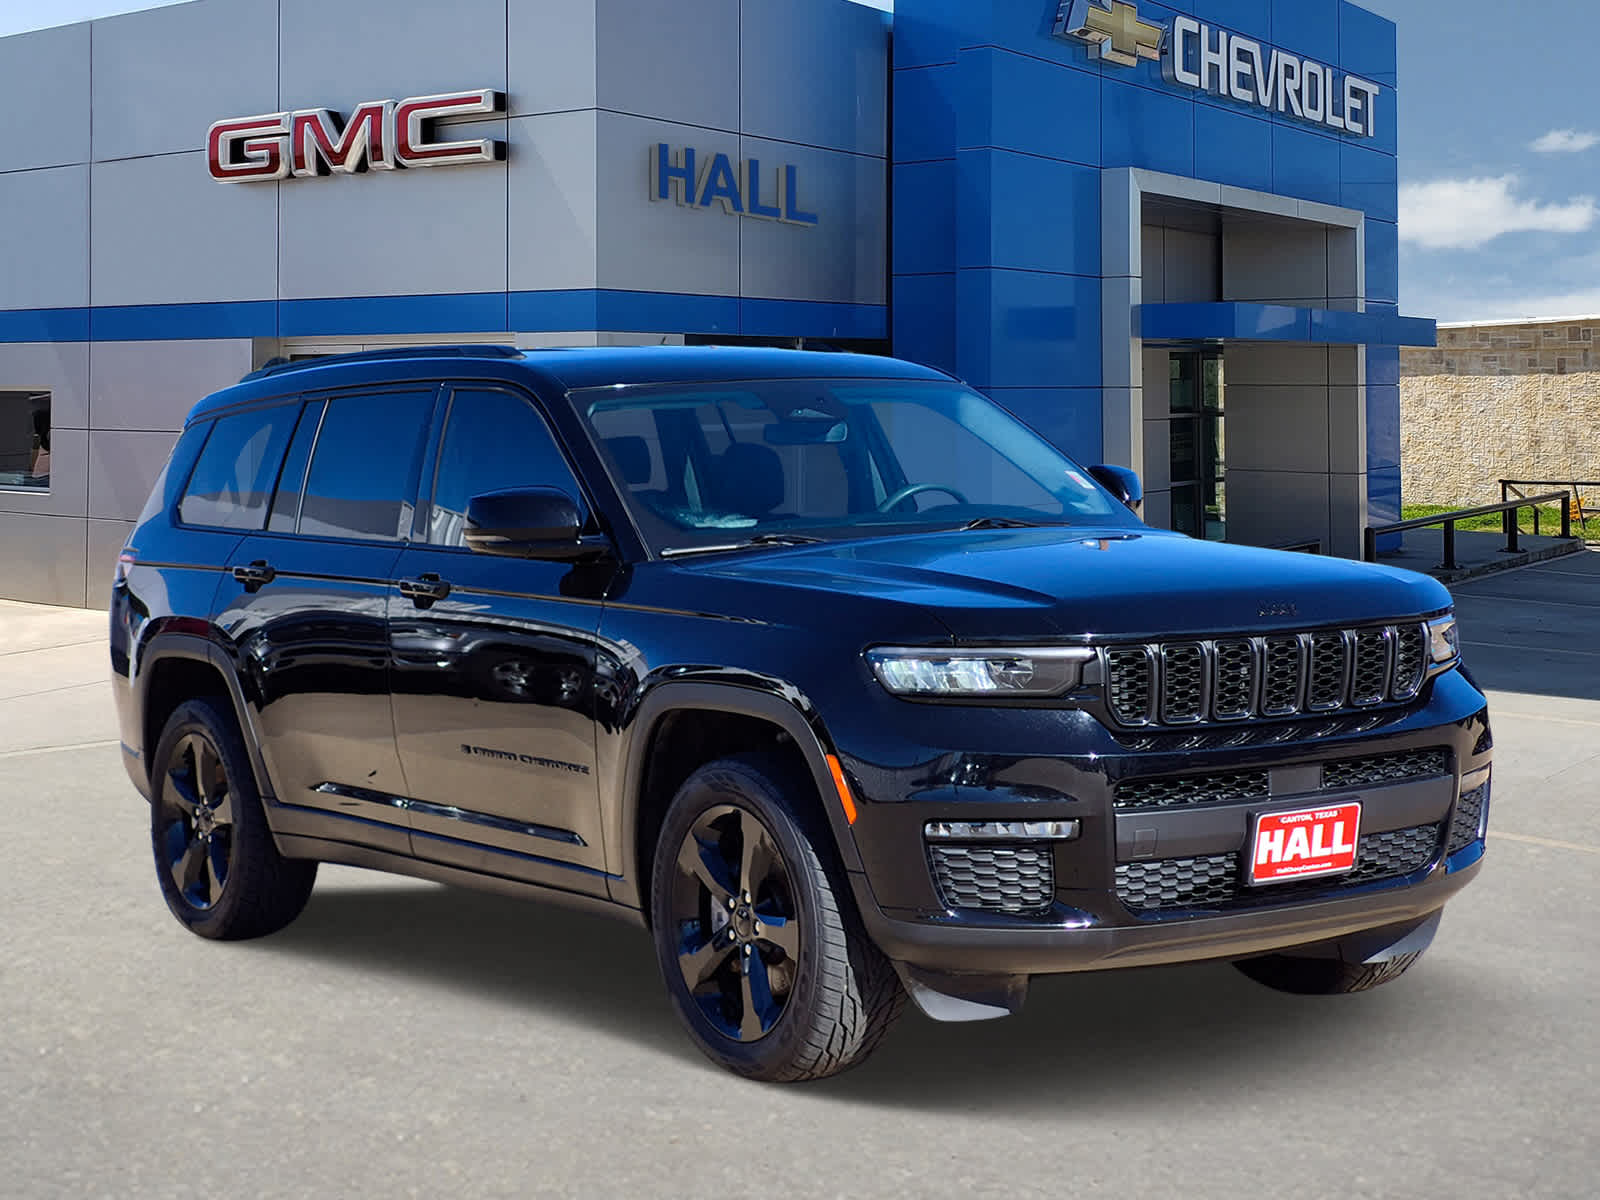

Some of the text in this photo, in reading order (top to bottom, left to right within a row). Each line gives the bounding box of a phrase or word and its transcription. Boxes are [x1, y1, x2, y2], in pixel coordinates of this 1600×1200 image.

[1174, 15, 1379, 137] CHEVROLET
[207, 88, 503, 184] GMC
[652, 142, 818, 226] HALL
[1256, 820, 1353, 865] HALL
[1280, 809, 1338, 824] CANTON, TEXAS
